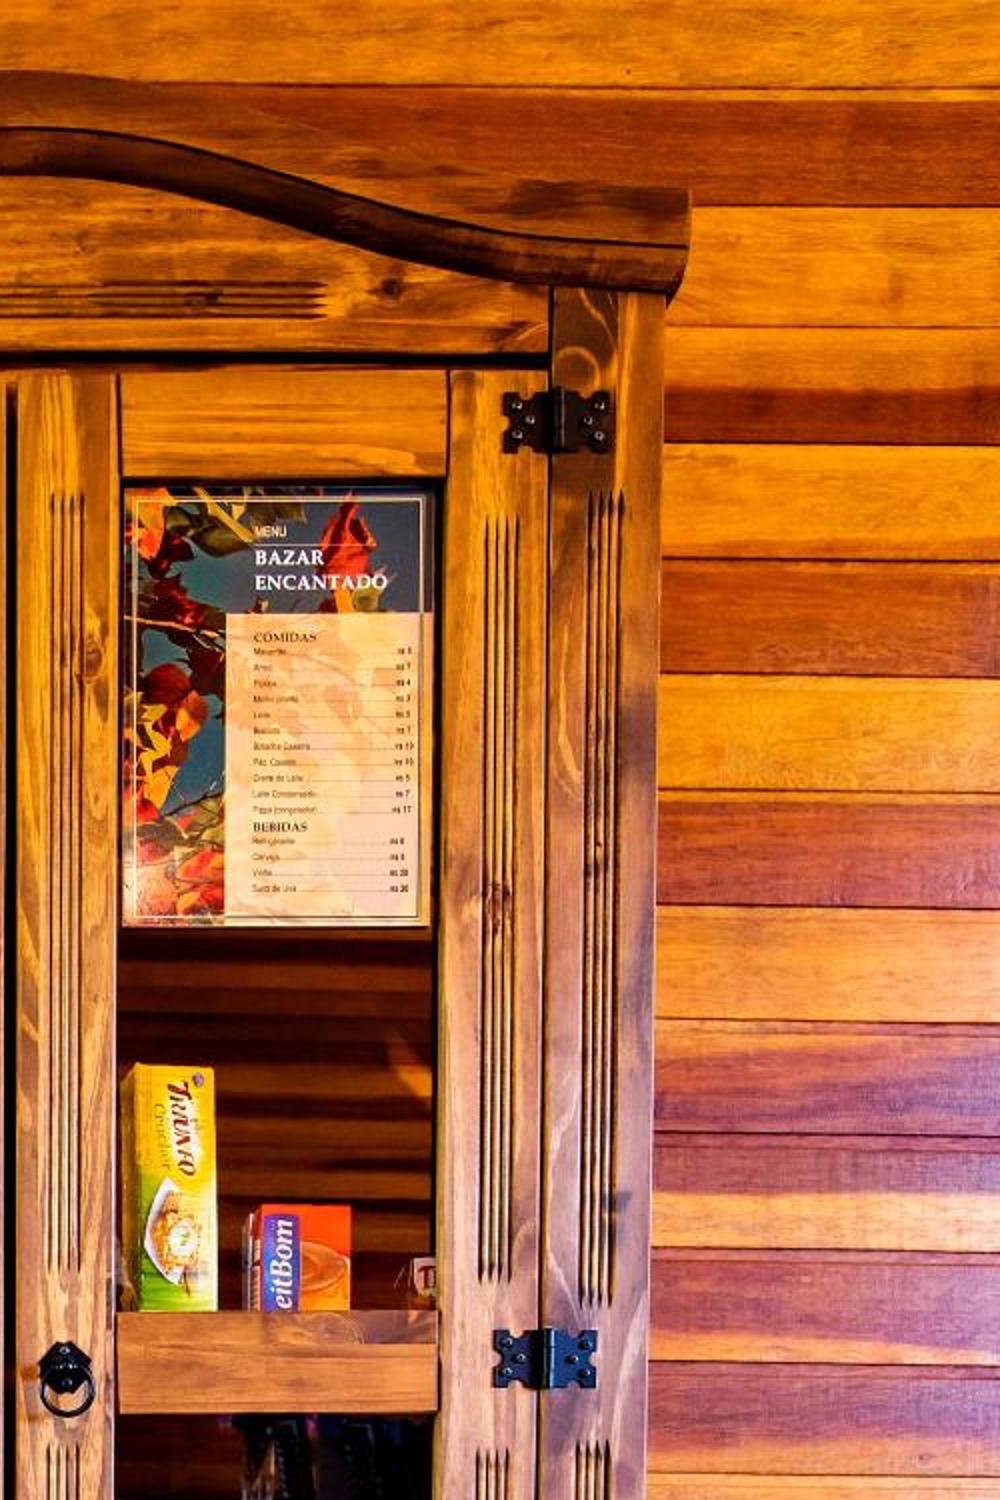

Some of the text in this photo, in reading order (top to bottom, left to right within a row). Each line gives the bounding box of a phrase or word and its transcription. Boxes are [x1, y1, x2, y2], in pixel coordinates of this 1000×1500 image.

[254, 525, 287, 537] MENU
[255, 550, 325, 566] BAZAR
[255, 574, 388, 591] ENCANTADO
[253, 631, 317, 642] COMIDAS
[253, 821, 308, 833] BEBIDAS
[270, 1219, 293, 1310] eitBom
